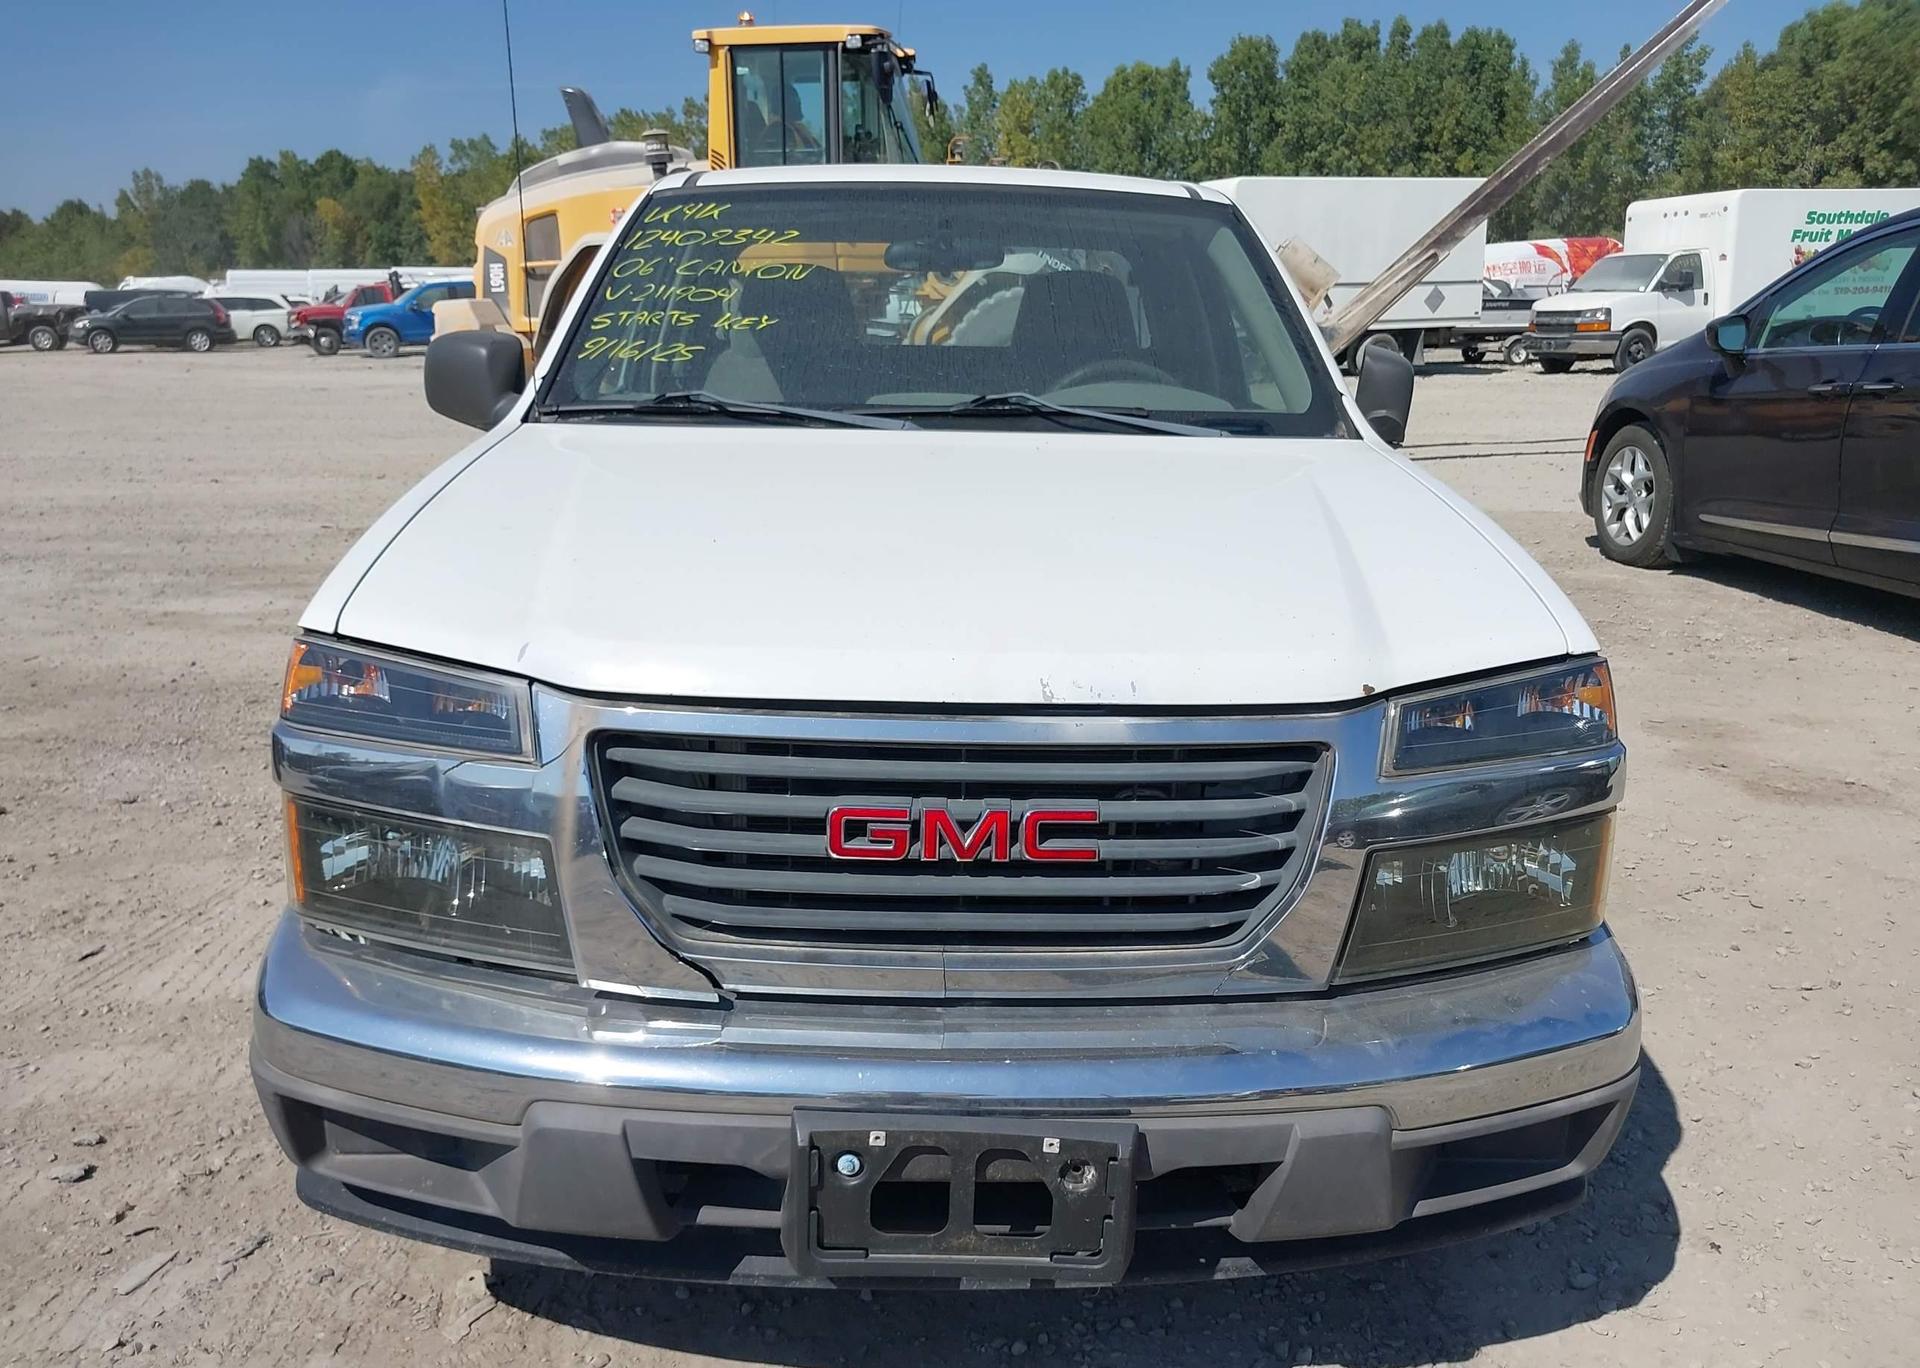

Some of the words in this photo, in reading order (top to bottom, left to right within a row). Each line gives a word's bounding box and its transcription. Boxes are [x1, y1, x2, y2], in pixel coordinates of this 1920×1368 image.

[1790, 228, 1833, 242] Fruit
[591, 311, 701, 330] STARTS
[713, 312, 779, 330] KEY
[577, 337, 706, 361] 9/16/25
[826, 806, 1099, 862] GMC
